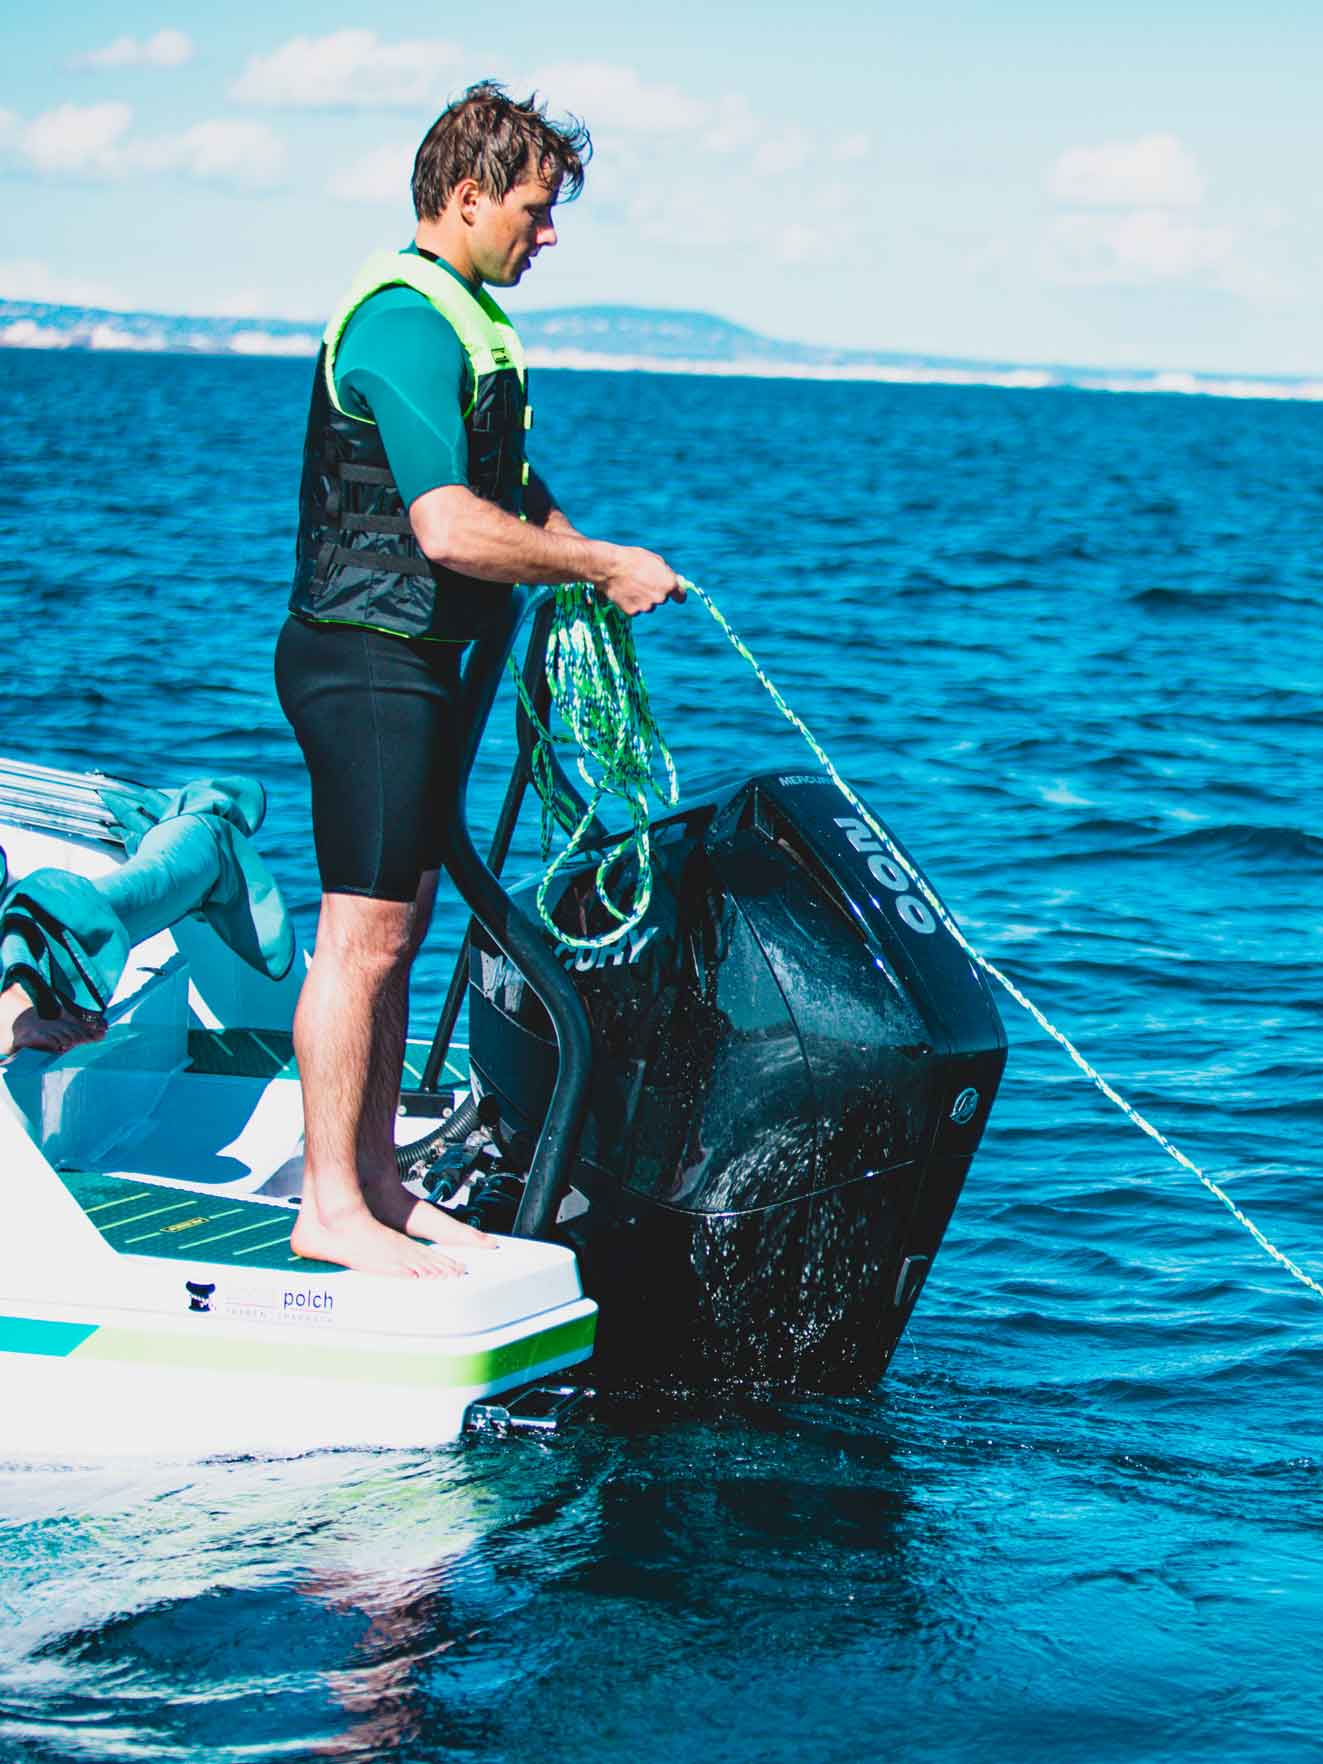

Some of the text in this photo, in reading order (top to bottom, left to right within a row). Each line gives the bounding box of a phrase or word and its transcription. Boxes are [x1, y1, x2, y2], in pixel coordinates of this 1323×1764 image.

[779, 775, 837, 787] MERCUR
[833, 817, 937, 935] 200
[283, 1289, 334, 1310] polch
